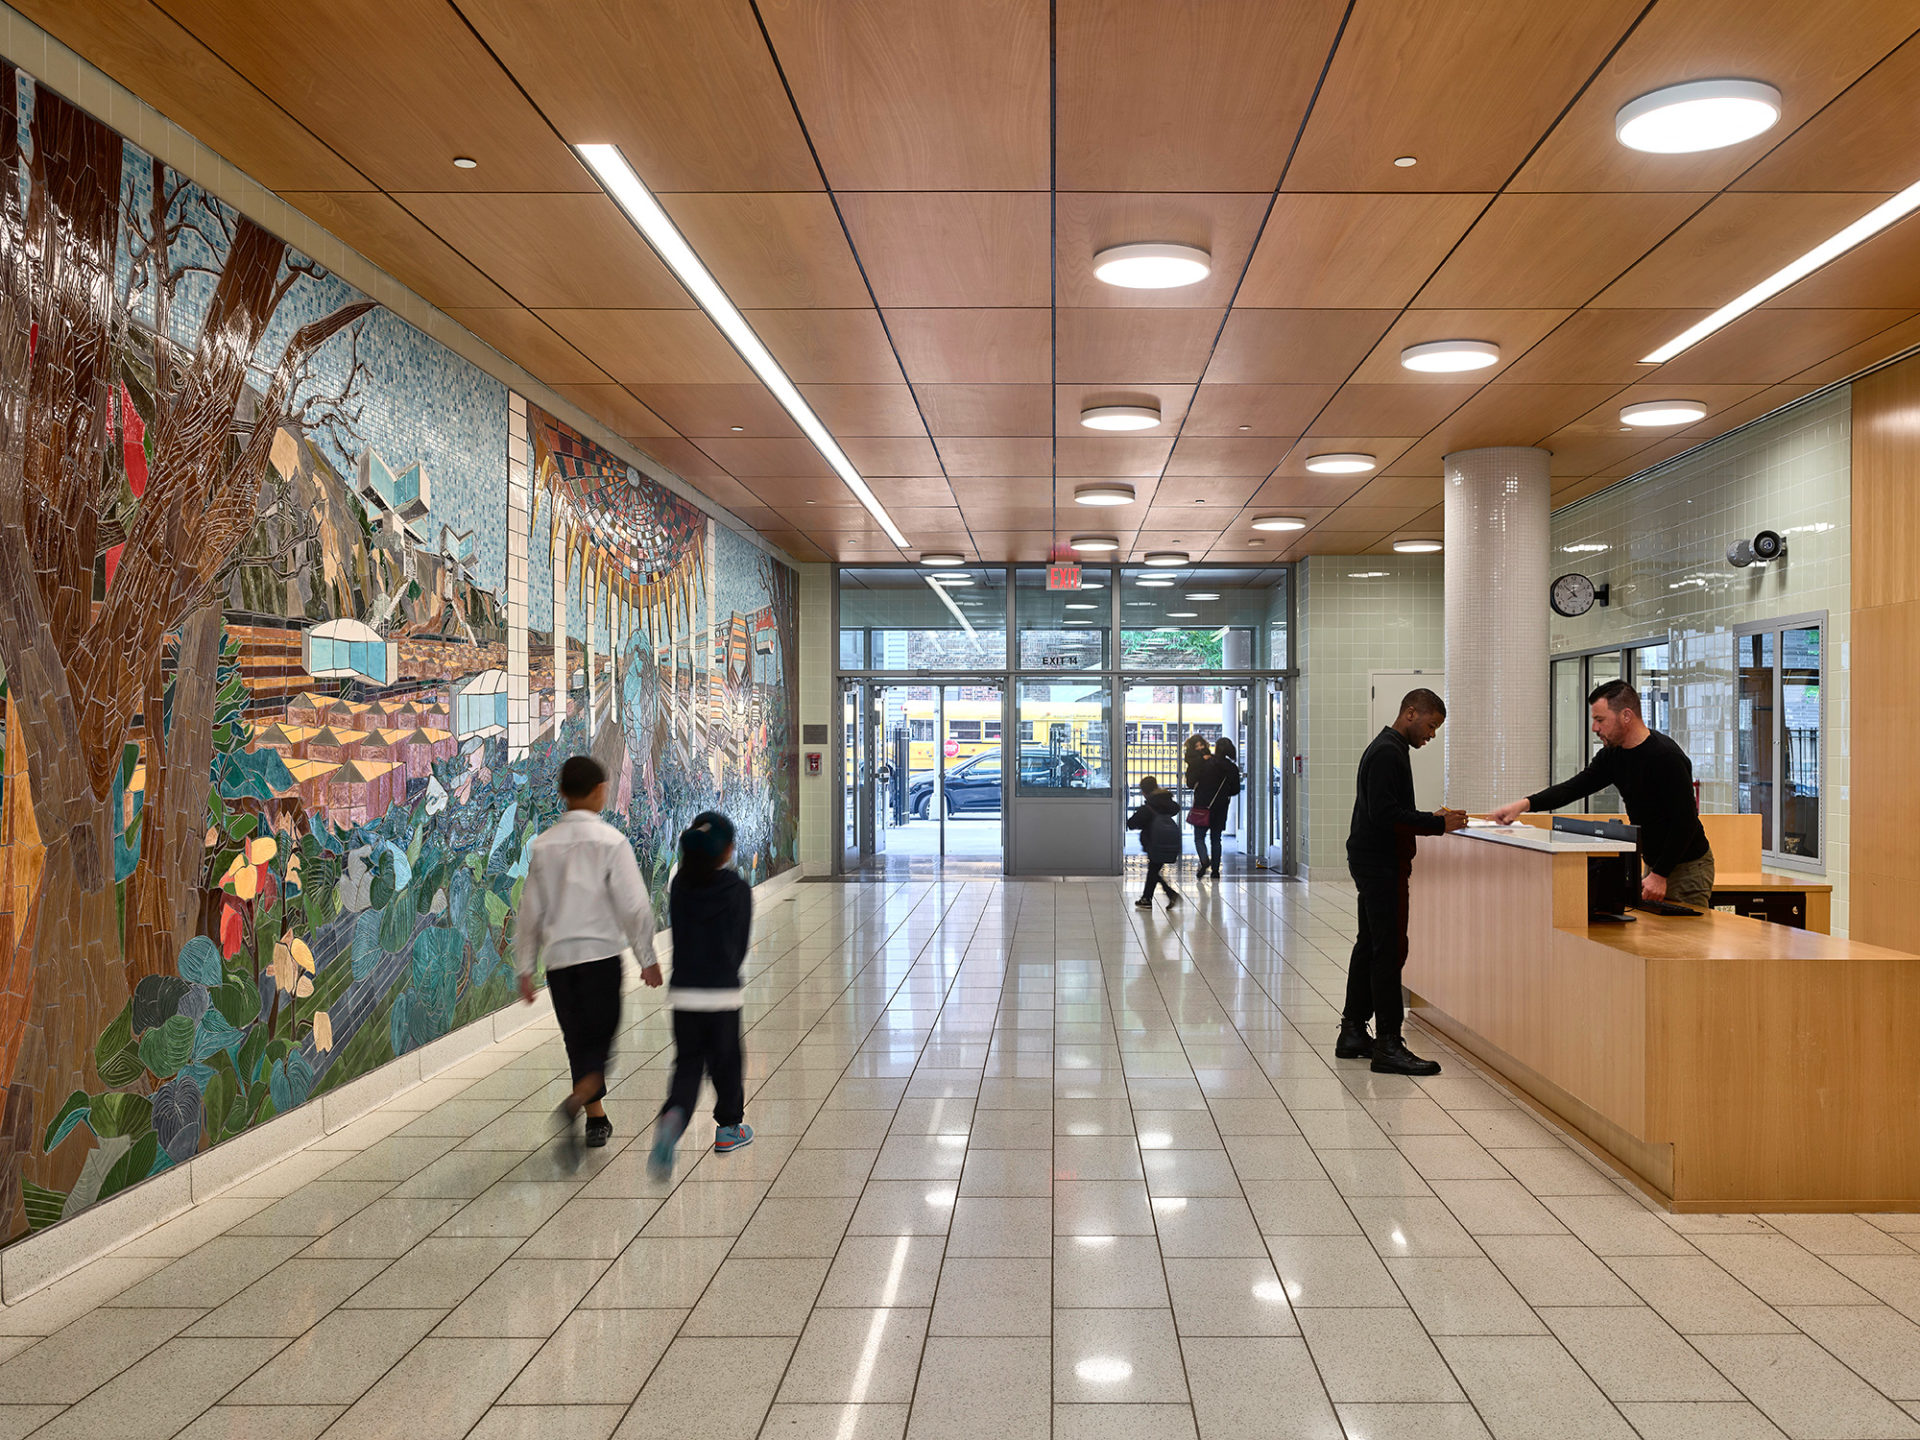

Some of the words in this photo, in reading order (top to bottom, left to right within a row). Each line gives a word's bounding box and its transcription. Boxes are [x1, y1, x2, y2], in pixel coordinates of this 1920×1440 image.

[1050, 567, 1080, 589] EXIT
[1042, 656, 1065, 665] EXIT
[1069, 656, 1078, 665] 14
